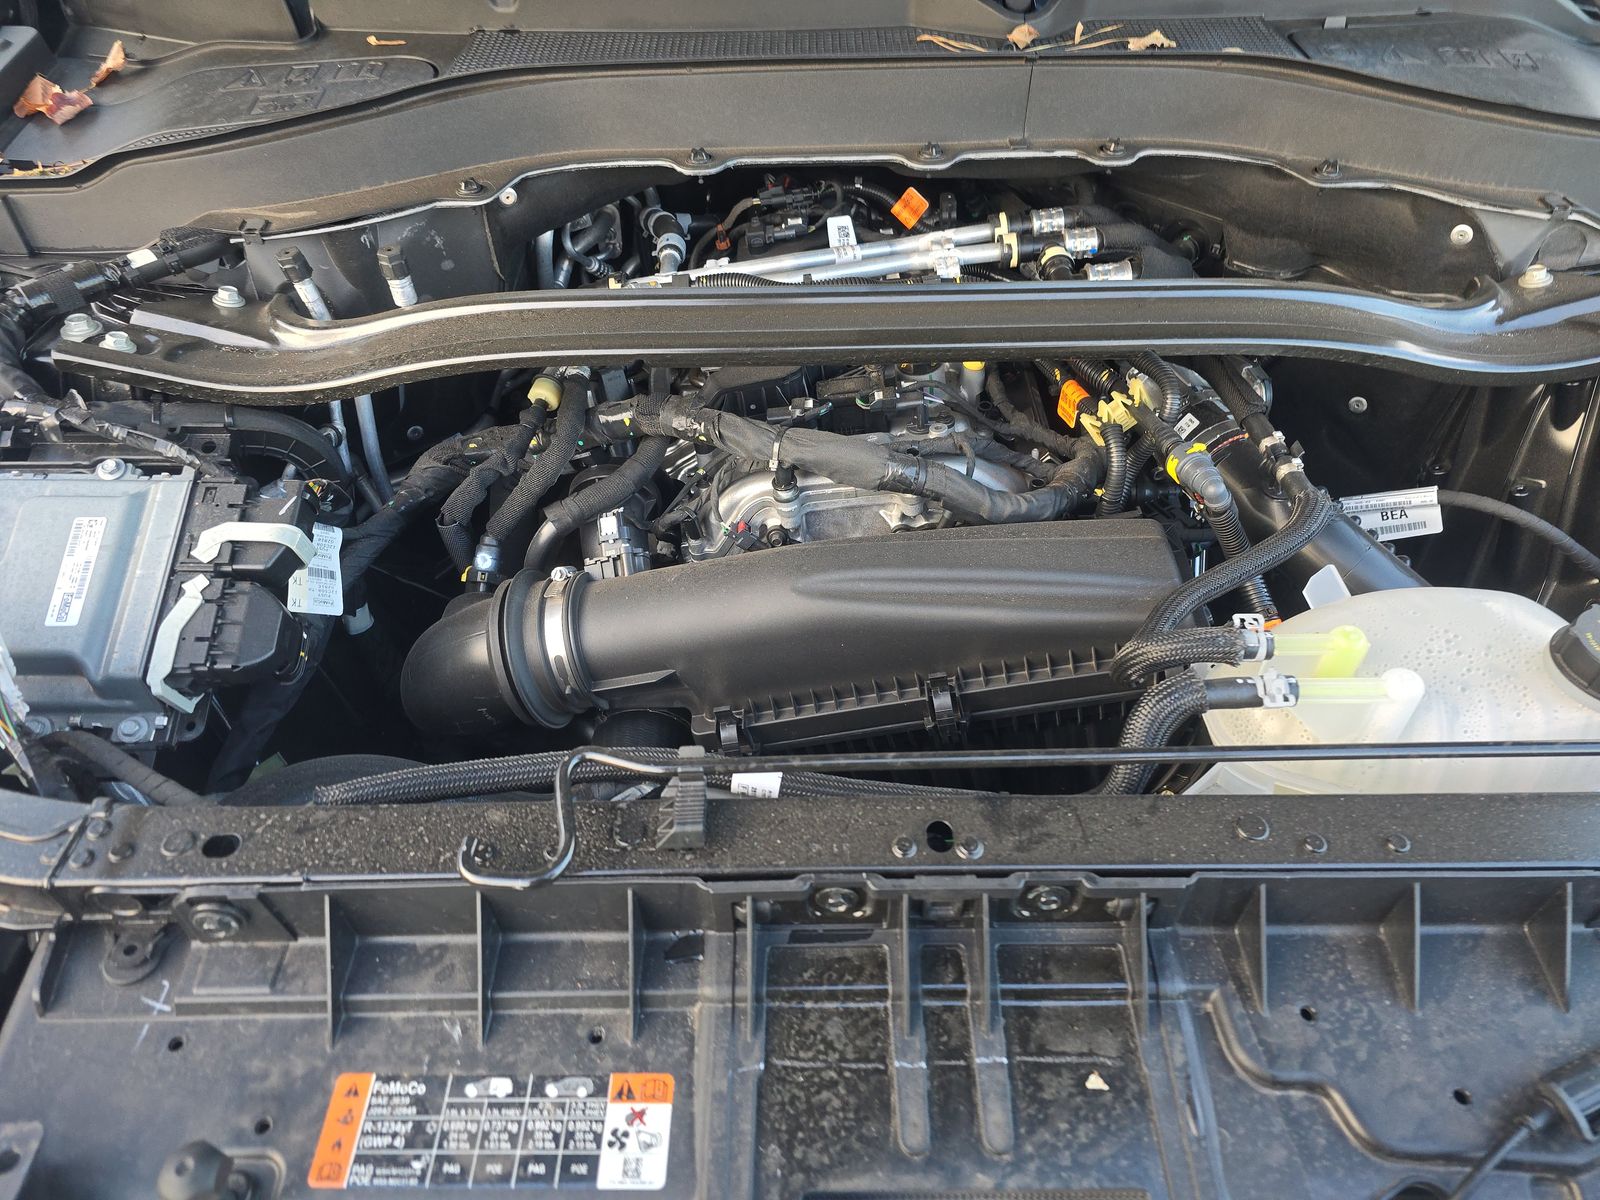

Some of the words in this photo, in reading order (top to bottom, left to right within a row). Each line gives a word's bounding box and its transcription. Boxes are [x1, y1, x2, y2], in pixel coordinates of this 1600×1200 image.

[1380, 508, 1409, 522] BEA
[291, 576, 303, 586] TK
[291, 597, 302, 608] TK
[373, 1080, 426, 1096] FoMoCo
[363, 1121, 413, 1135] R-1234yf
[359, 1134, 393, 1150] (GWP
[393, 1134, 406, 1150] 4)
